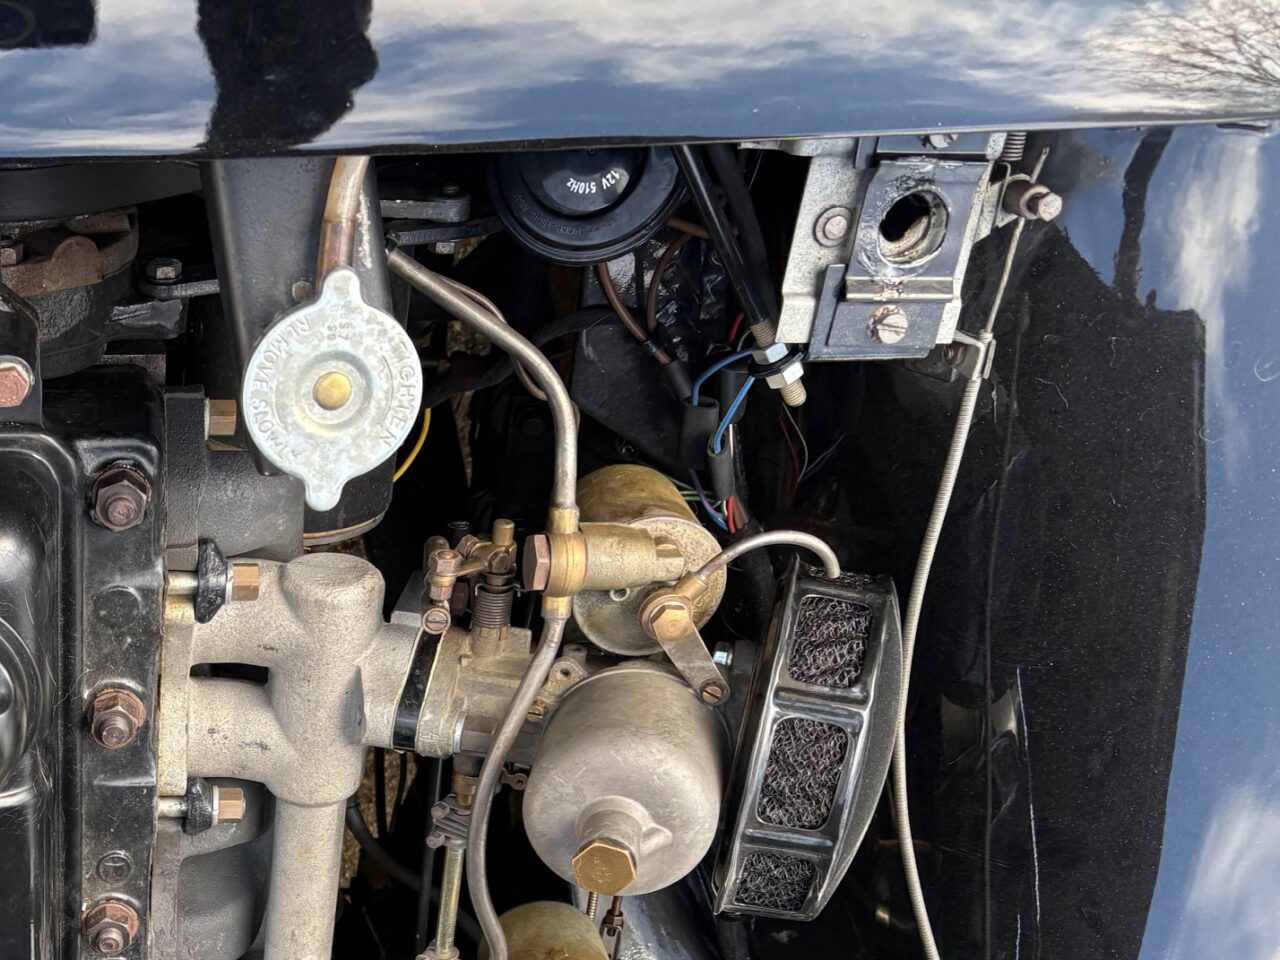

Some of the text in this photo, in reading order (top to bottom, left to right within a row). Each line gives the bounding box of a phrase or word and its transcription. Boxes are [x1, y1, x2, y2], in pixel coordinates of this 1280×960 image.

[566, 170, 620, 194] 12V 510Hz
[380, 339, 416, 448] TIGHTEN
